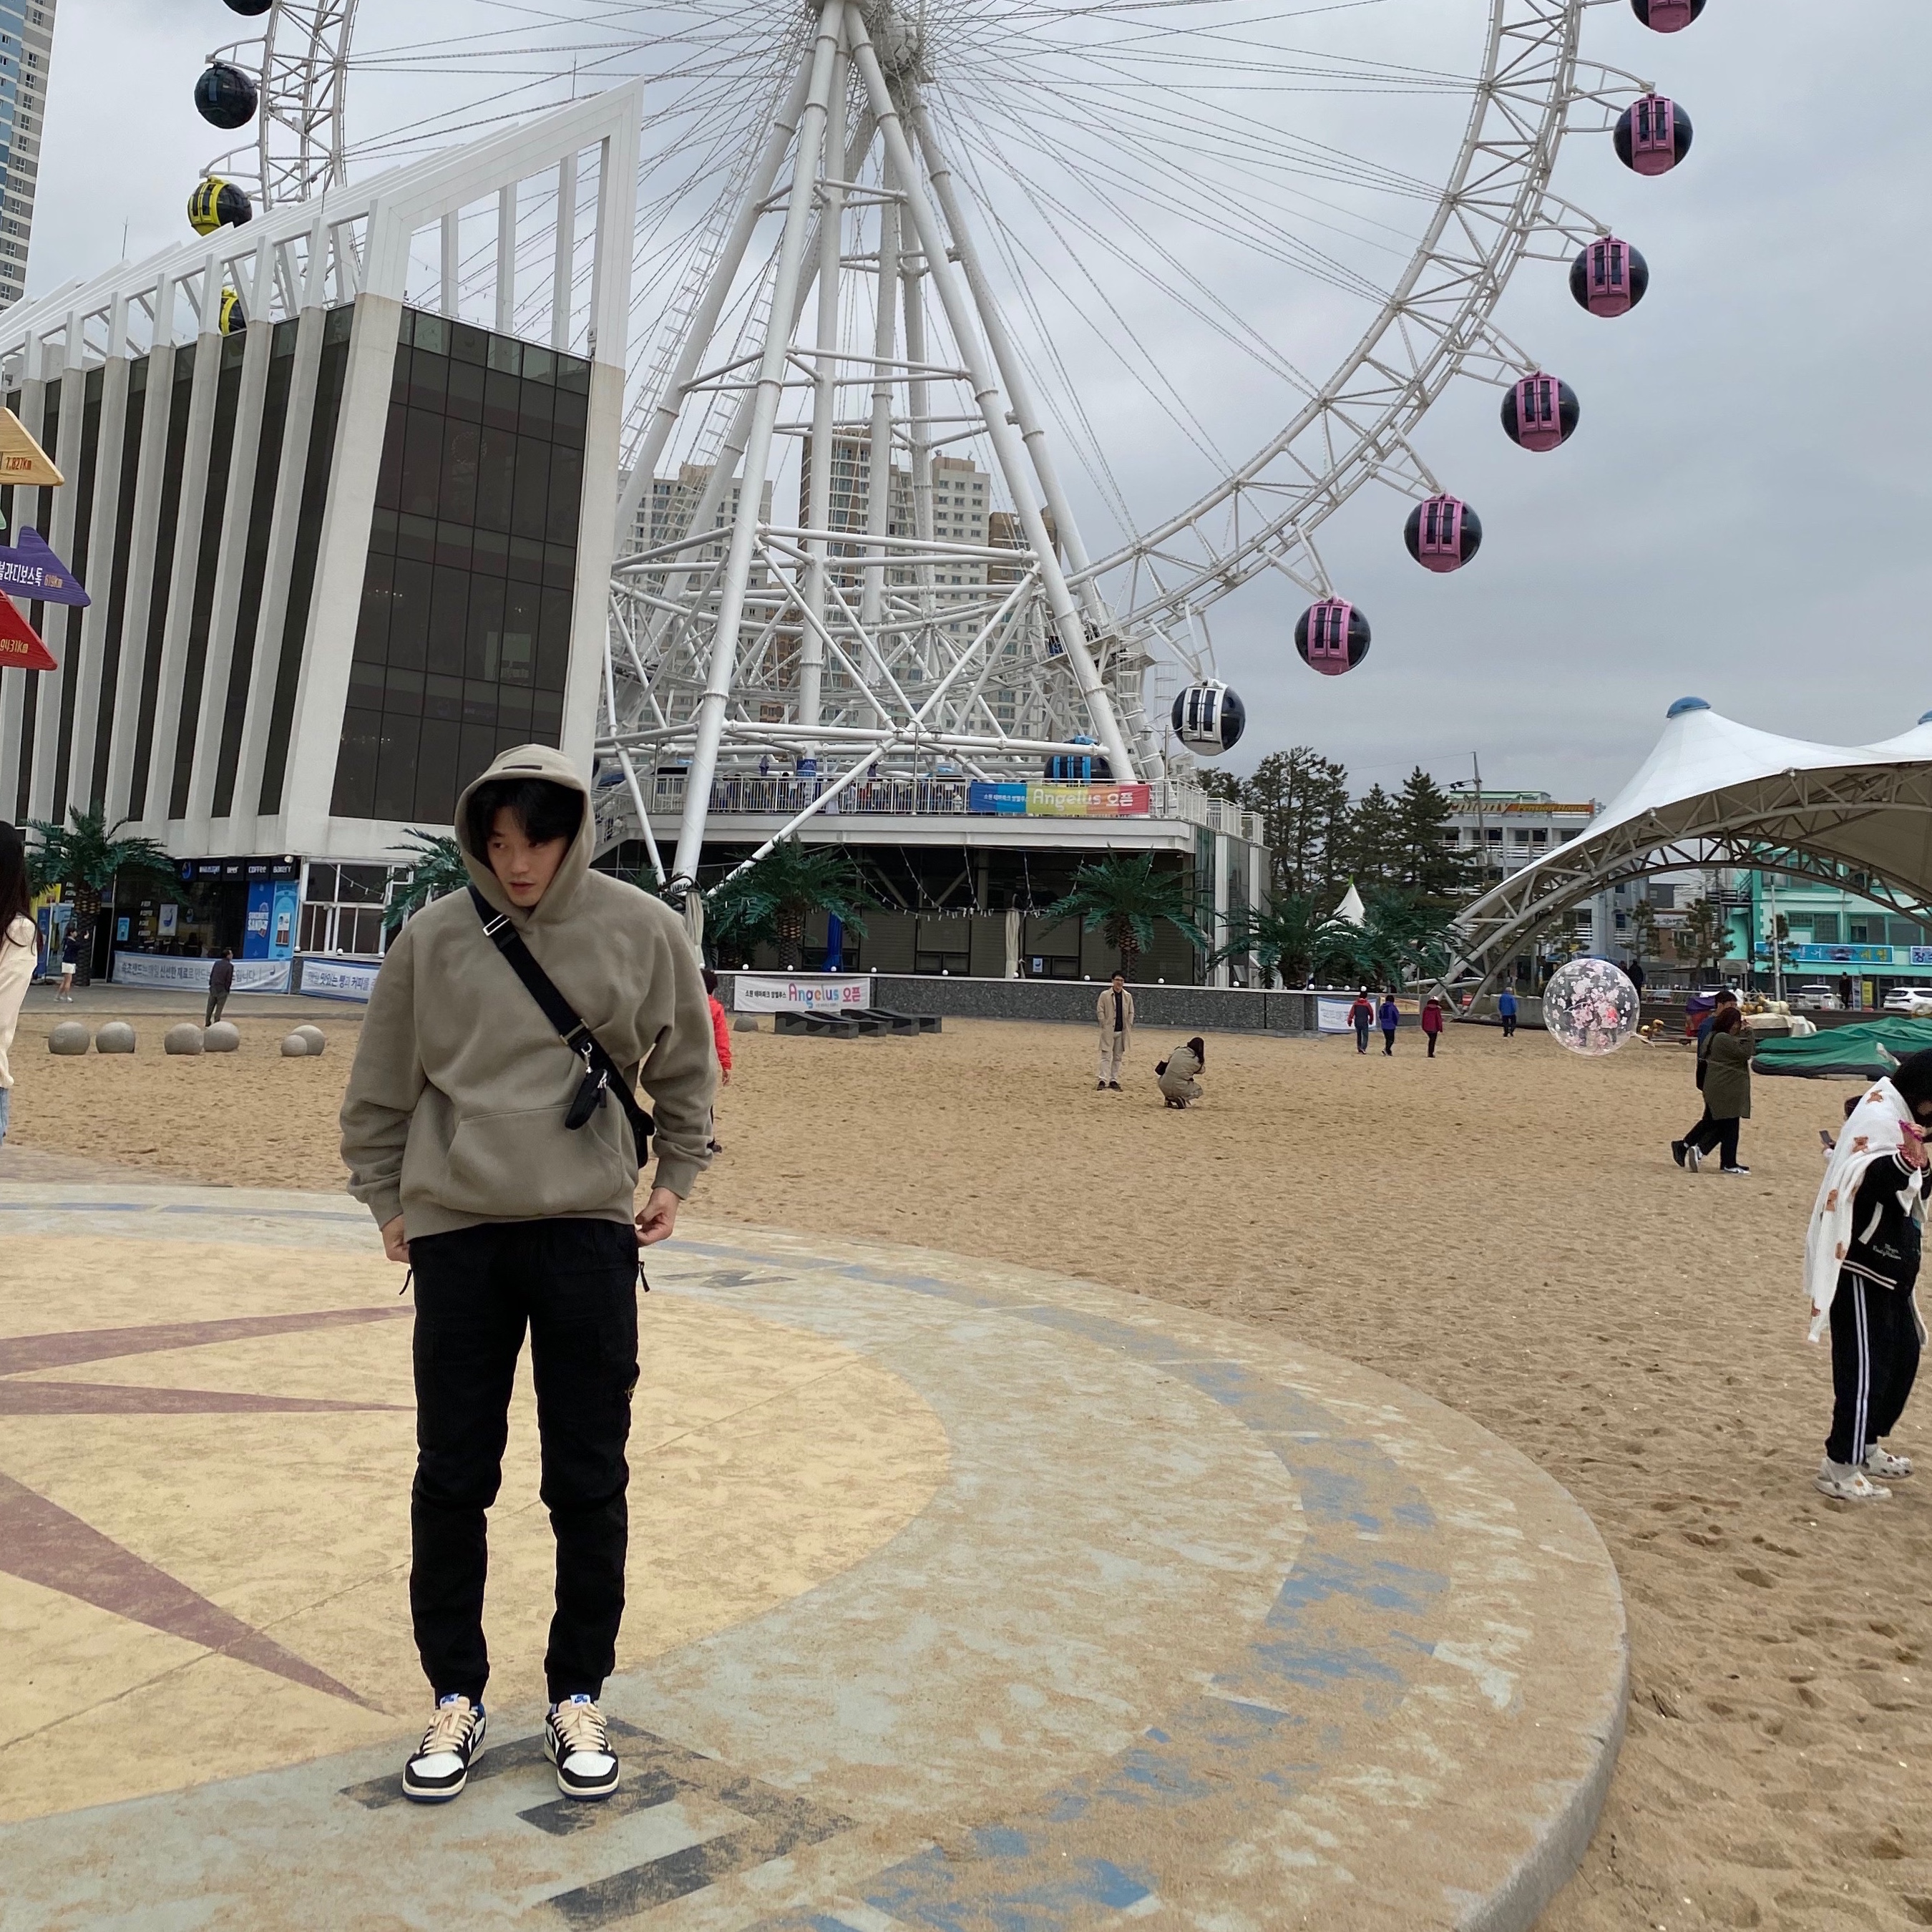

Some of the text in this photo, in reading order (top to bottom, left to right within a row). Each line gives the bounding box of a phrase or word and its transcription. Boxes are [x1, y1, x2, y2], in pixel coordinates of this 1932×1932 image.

[1033, 789, 1101, 811] Angelus
[1106, 792, 1133, 807] 오픈
[160, 965, 176, 980] 신선한
[320, 972, 338, 987] 맛있는
[339, 975, 351, 988] 빵과
[351, 977, 369, 991] 커피를
[789, 982, 839, 1009] Angelus
[842, 987, 861, 1002] 오픈
